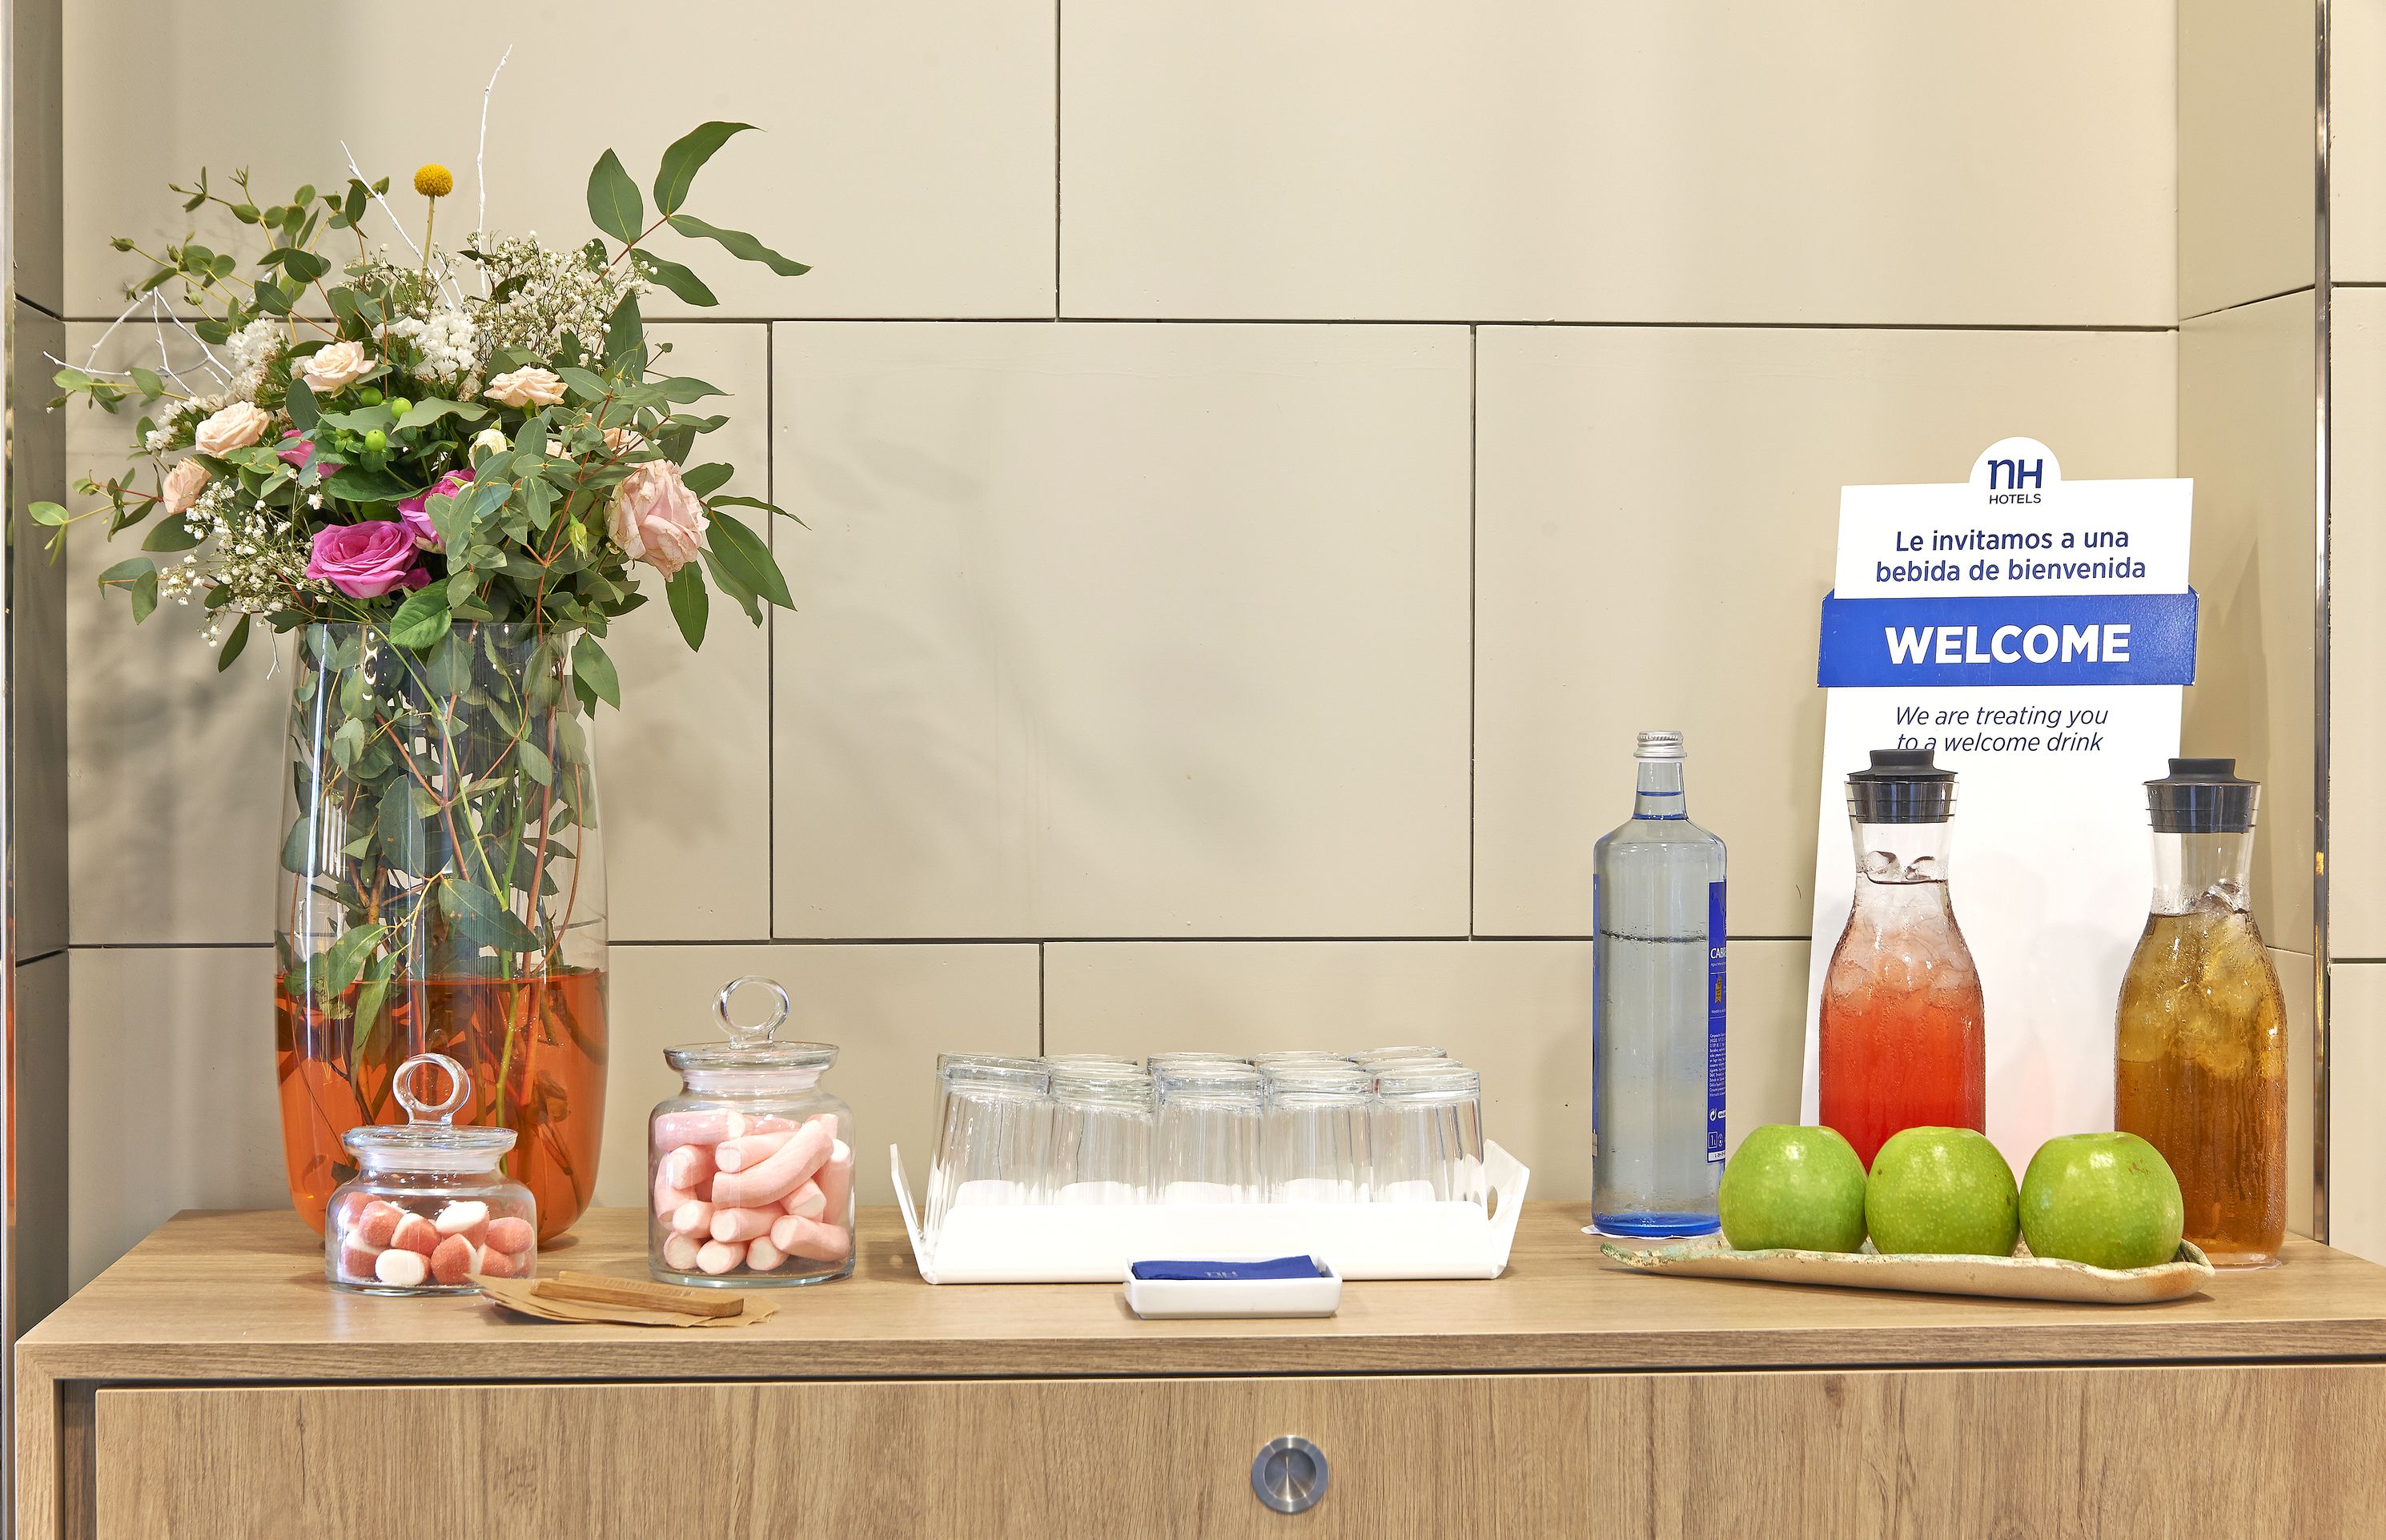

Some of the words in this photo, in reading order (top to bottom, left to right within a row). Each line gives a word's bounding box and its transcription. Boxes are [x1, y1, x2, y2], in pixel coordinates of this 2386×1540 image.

[1989, 493, 2042, 505] HOTELS
[1896, 531, 1924, 551] Le
[1932, 529, 2053, 551] invitamos
[2061, 532, 2075, 549] a
[2084, 531, 2129, 548] una
[1876, 559, 1960, 583] bebida
[1969, 559, 1999, 581] de
[2008, 556, 2146, 580] bienvenida
[1885, 624, 2131, 664] WELCOME
[1896, 706, 1930, 725] We
[1934, 710, 1970, 725] are
[1976, 705, 2063, 728] treating
[2066, 710, 2109, 728] you
[1898, 733, 1918, 750] to
[1924, 736, 1937, 750] a
[1945, 732, 2040, 752] welcome
[2047, 732, 2104, 752] drink
